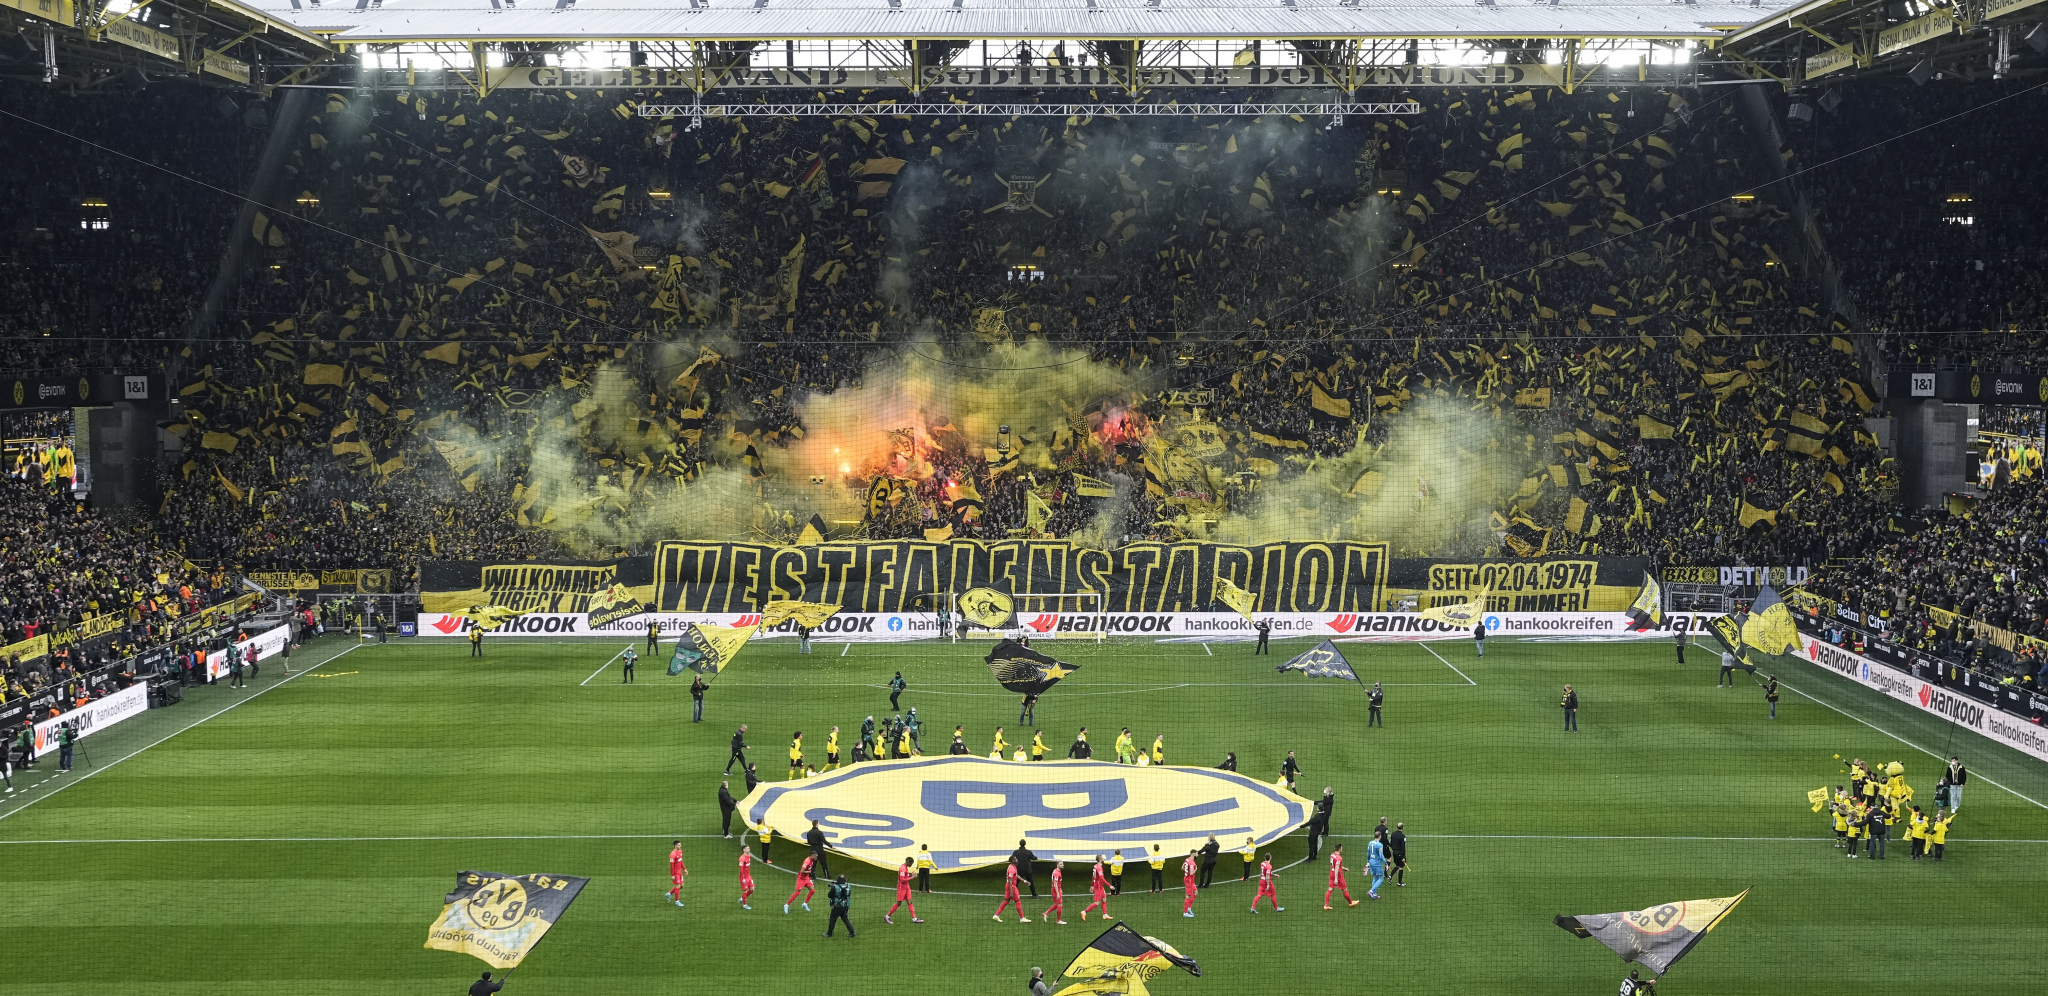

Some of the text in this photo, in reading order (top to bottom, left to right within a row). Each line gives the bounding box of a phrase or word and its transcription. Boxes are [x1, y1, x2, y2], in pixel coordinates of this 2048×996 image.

[108, 23, 177, 53] SIGNAL IDUNA PARK
[1880, 15, 1951, 49] SIGNAL IDUNA PARK
[528, 68, 848, 88] GELBE WAND
[1247, 67, 1525, 87] DORTMUND
[126, 381, 146, 393] 1&1
[1913, 378, 1933, 390] 1&1
[248, 572, 297, 580] RENNSTEIG
[252, 579, 295, 588] ORUSSEN
[1432, 563, 1592, 591] SEIT 02.04.1974
[1664, 568, 1700, 583] BRB
[1514, 588, 1590, 612] IMMER!
[1505, 616, 1613, 630] hankookreifen
[1836, 602, 1859, 623] Selm
[1867, 613, 1887, 633] City
[402, 624, 413, 633] 1&1
[1869, 667, 1913, 698] hankookreifen
[1989, 714, 2048, 754] hankookreifen.
